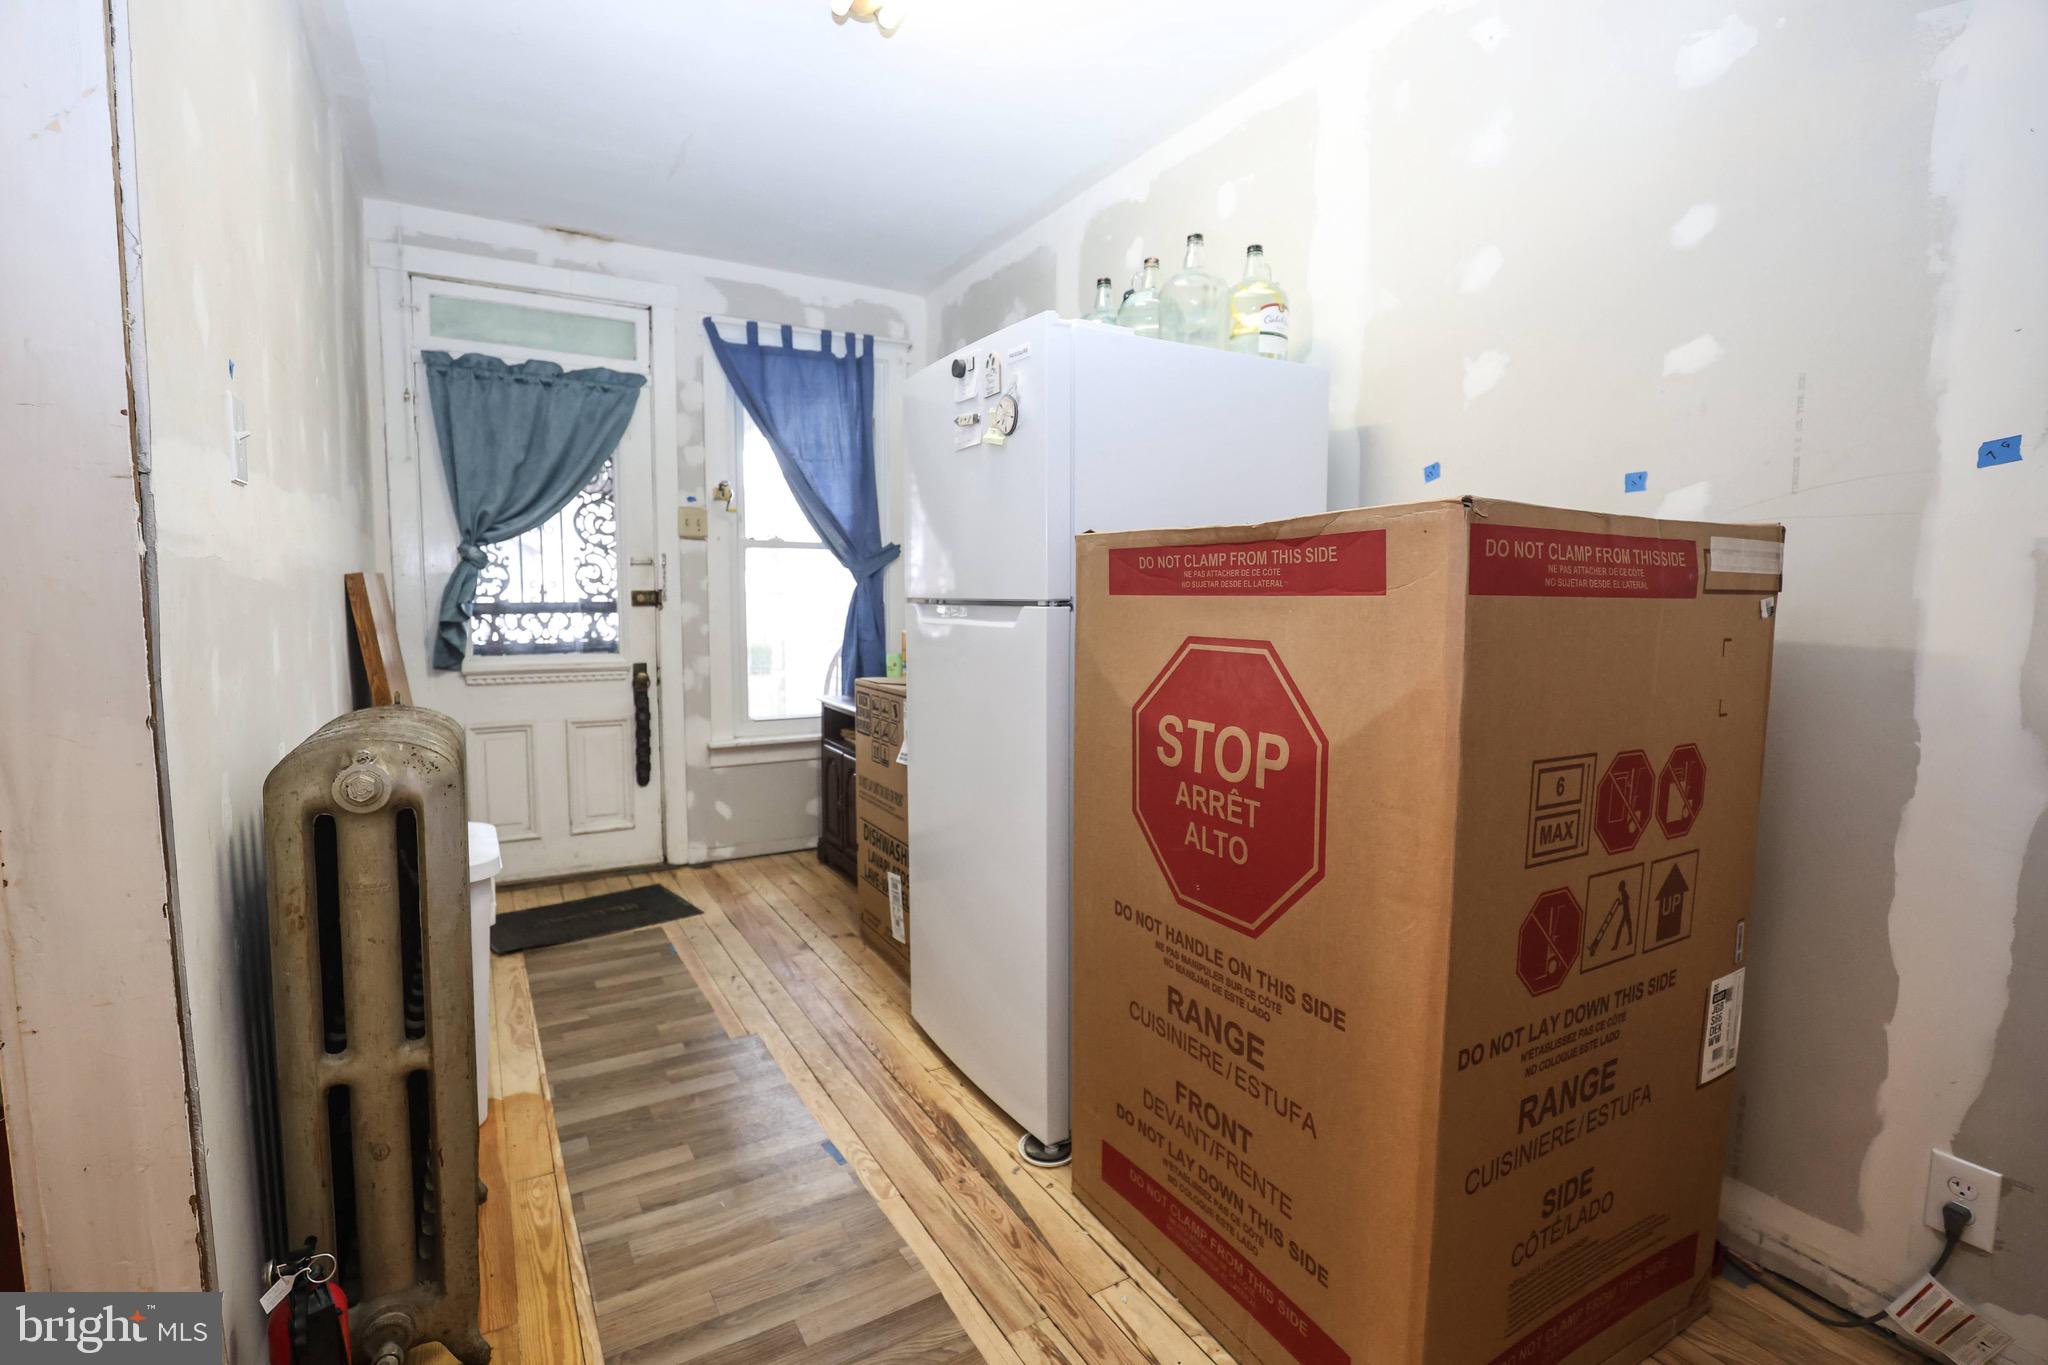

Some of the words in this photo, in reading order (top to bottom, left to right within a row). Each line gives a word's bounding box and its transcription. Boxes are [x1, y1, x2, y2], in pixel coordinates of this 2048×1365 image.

[1139, 556, 1155, 569] DO
[1158, 554, 1181, 569] NOT
[1184, 551, 1227, 568] CLAMP
[1230, 549, 1267, 566] FROM
[1272, 547, 1302, 564] THIS
[1306, 546, 1338, 563] SIDE
[1207, 569, 1240, 578] ATTACHER
[1485, 539, 1510, 559] DO
[1514, 540, 1545, 560] NOT
[1548, 543, 1592, 563] CLAMP
[1595, 547, 1631, 564] FROM
[1191, 580, 1220, 589] SUJETAR
[1220, 580, 1243, 588] DESDE
[1156, 714, 1290, 790] STOP
[1175, 780, 1261, 829] ARRÊT
[1555, 775, 1566, 797] 6
[1184, 820, 1249, 866] ALTO
[1539, 820, 1574, 846] MAX
[1662, 893, 1682, 917] UP
[1114, 899, 1133, 921] DO
[1136, 909, 1162, 936] NOT
[1166, 925, 1224, 969] HANDLE
[1228, 956, 1252, 982] ON
[1256, 969, 1297, 1005] THIS
[1301, 992, 1347, 1032] SIDE
[1167, 984, 1266, 1072] RANGE
[1457, 1043, 1484, 1072] DO
[1489, 1026, 1525, 1059] NOT
[1528, 1012, 1560, 1043] LAY
[1563, 995, 1610, 1029] DOWN
[1614, 981, 1644, 1009] THIS
[1647, 968, 1678, 996] SIDE
[1175, 1079, 1254, 1154] FRONT
[1517, 1058, 1618, 1134] RANGE
[1115, 1102, 1136, 1127] DO
[1137, 1117, 1165, 1149] NOT
[1168, 1140, 1195, 1171] LAY
[1198, 1164, 1244, 1215] DOWN
[1248, 1203, 1285, 1249] THIS
[1288, 1239, 1329, 1289] SIDE
[1541, 1167, 1595, 1221] SIDE
[1146, 1183, 1168, 1209] NOT
[1169, 1202, 1208, 1242] CLAMP
[1209, 1235, 1244, 1277] FROM
[1247, 1270, 1275, 1306] THIS
[1278, 1299, 1309, 1338] SIDE
